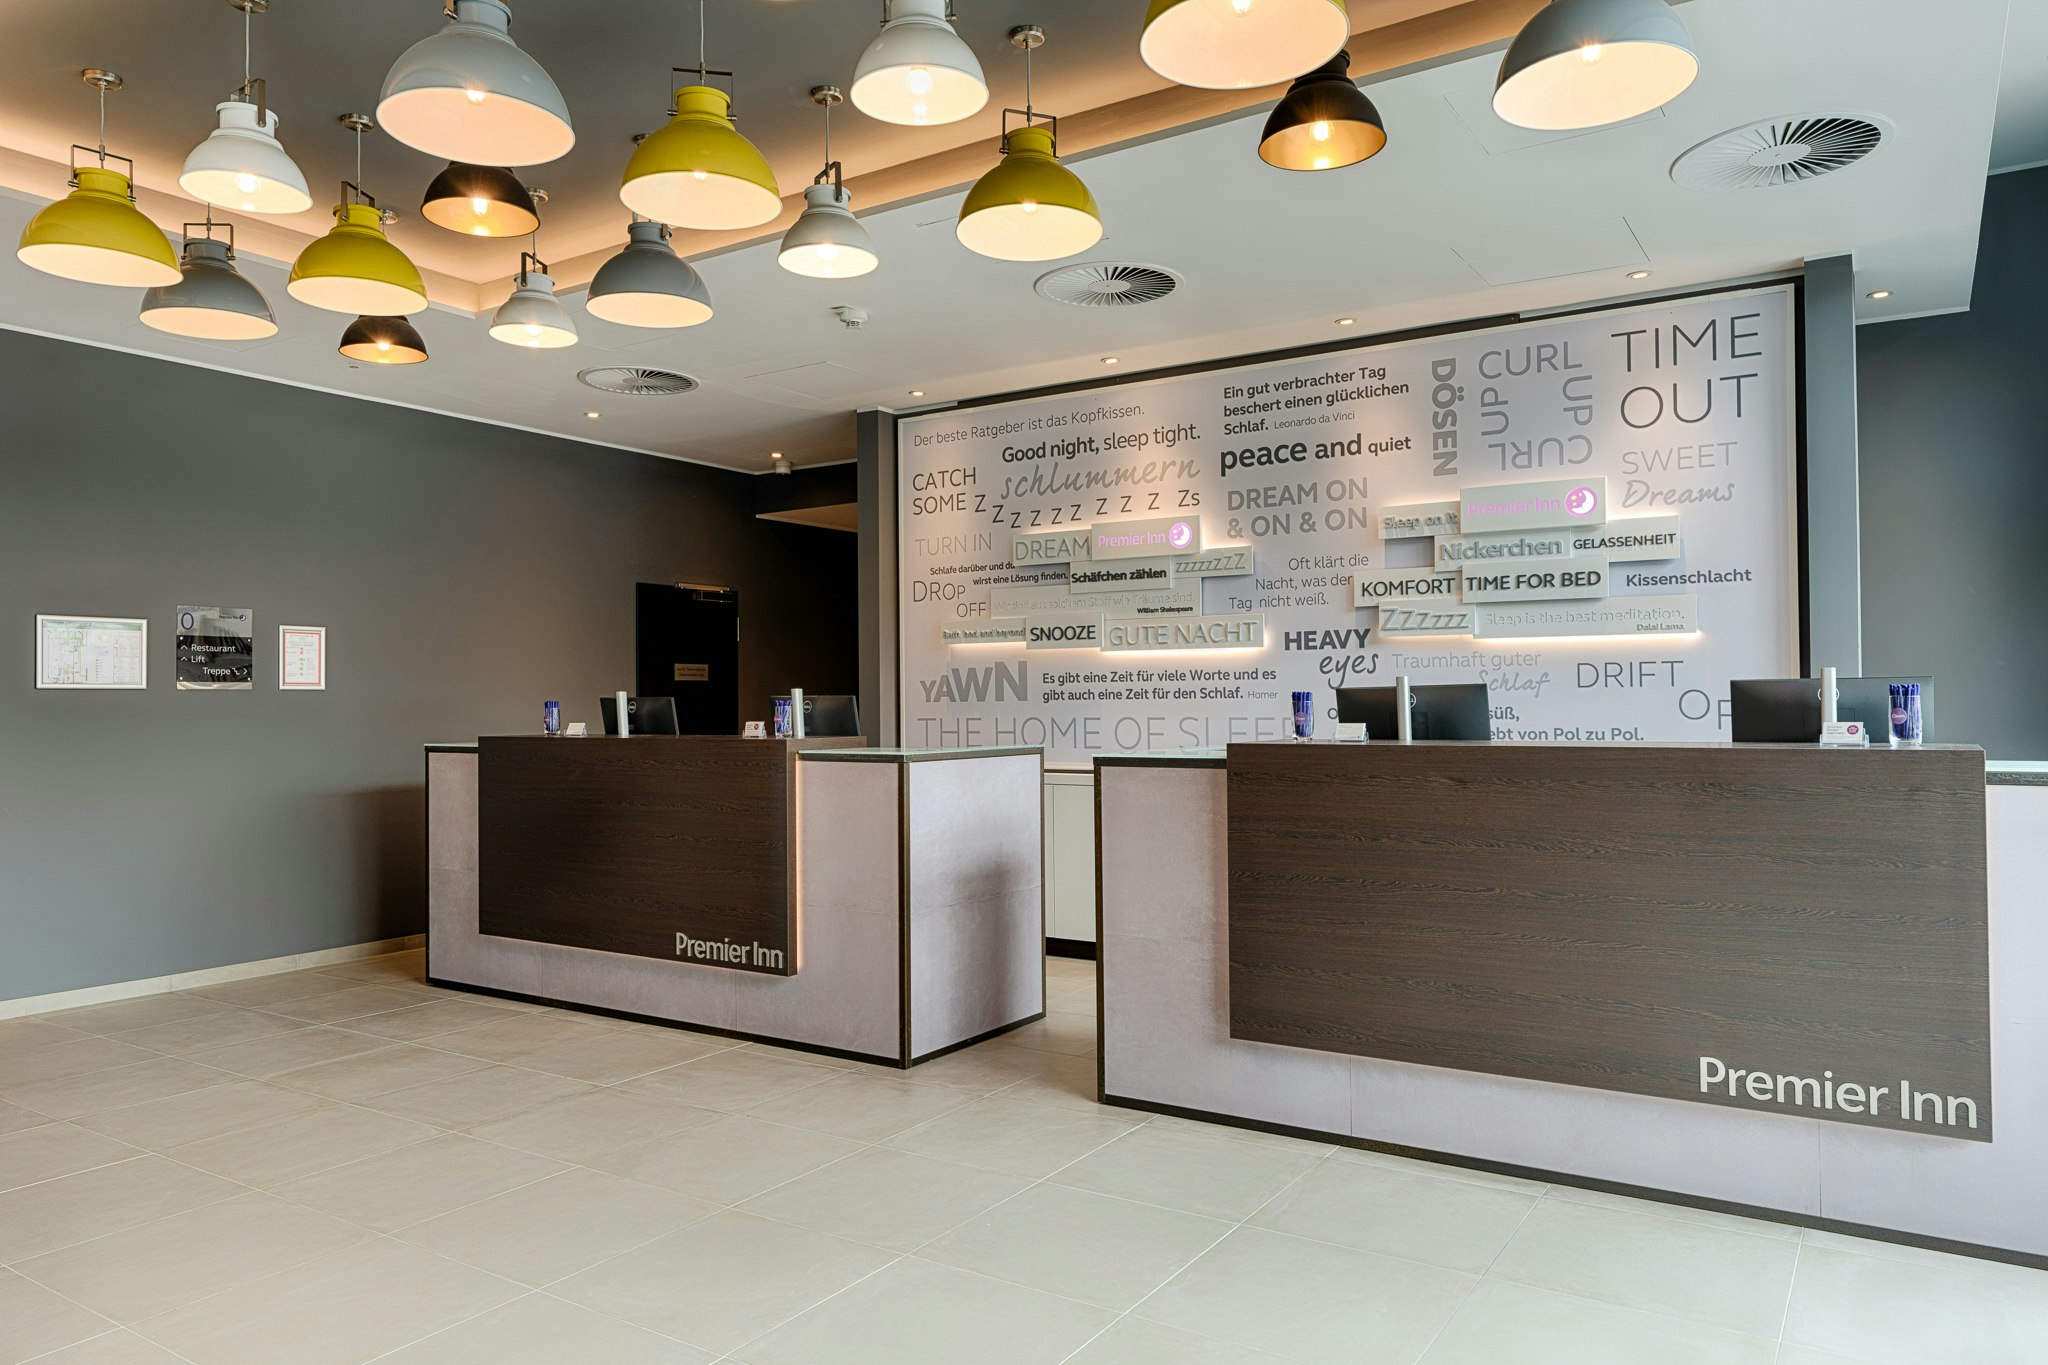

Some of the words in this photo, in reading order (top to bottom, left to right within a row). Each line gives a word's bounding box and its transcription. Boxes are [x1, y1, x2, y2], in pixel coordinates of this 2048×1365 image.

[1611, 313, 1762, 372] TIME
[1478, 341, 1583, 379] CURL
[1224, 386, 1244, 400] Ein
[1246, 382, 1270, 398] gut
[1273, 370, 1356, 394] verbrachter
[1358, 366, 1386, 380] Tag
[1224, 401, 1282, 417] beschert
[1284, 395, 1322, 408] einen
[1326, 382, 1409, 407] glücklichen
[1480, 387, 1509, 436] UP
[1562, 375, 1593, 426] UP
[1620, 373, 1758, 428] OUT
[914, 435, 934, 446] Der
[936, 430, 968, 444] beste
[971, 420, 1025, 439] Ratgeber
[1028, 417, 1042, 430] ist
[1046, 414, 1068, 428] das
[1071, 405, 1145, 425] Kopfkissen.
[1224, 419, 1269, 436] Schlaf.
[1274, 416, 1317, 429] Leonardo
[1318, 414, 1330, 424] da
[1332, 411, 1355, 422] Vinci
[1431, 357, 1465, 476] DÖSEN
[1002, 441, 1046, 463] Good
[1050, 436, 1100, 459] night,
[1104, 432, 1148, 451] sleep
[1153, 424, 1201, 448] tight.
[1220, 441, 1307, 477] peace
[1314, 433, 1362, 460] and
[1368, 436, 1412, 457] quiet
[1488, 434, 1593, 470] CURL
[1622, 442, 1738, 475] SWEET
[912, 466, 976, 492] CATCH
[1001, 459, 1200, 500] schlummern
[912, 492, 966, 516] SOME
[1228, 482, 1318, 511] DREAM
[1326, 477, 1368, 502] ON
[1622, 479, 1736, 508] Dreams
[1468, 499, 1530, 518] Premier
[1535, 497, 1560, 513] Inn
[1226, 518, 1244, 538] &
[1250, 513, 1290, 537] ON
[1300, 512, 1317, 533] &
[1324, 507, 1367, 530] ON
[1384, 516, 1420, 530] Sleep
[1426, 515, 1442, 526] on
[914, 535, 967, 557] TURN
[974, 532, 992, 552] IN
[1015, 536, 1090, 560] DREAM
[1098, 533, 1145, 548] Premier
[1148, 532, 1166, 544] Inn
[1440, 538, 1562, 560] Nickerchen
[1573, 533, 1676, 550] GELASSENHEIT
[930, 566, 957, 576] Schlafe
[958, 563, 987, 574] darüber
[988, 562, 1004, 570] und
[1288, 556, 1310, 570] Oft
[1314, 555, 1344, 568] klärt
[1348, 554, 1369, 566] die
[972, 576, 992, 586] wirst
[992, 576, 1010, 584] eine
[1010, 574, 1039, 585] Lösung
[1040, 572, 1069, 580] finden.
[1071, 570, 1128, 584] Schäfchen
[1129, 568, 1167, 580] zählen
[1255, 577, 1298, 590] Nacht,
[1301, 576, 1326, 588] was
[1330, 574, 1353, 586] der
[1362, 578, 1456, 598] KOMFORT
[1466, 575, 1511, 592] TIME
[1516, 573, 1555, 589] FOR
[1561, 570, 1602, 587] BED
[1626, 568, 1752, 588] Kissenschlacht
[913, 580, 966, 602] DROP
[1132, 593, 1171, 604] Träume
[1228, 598, 1252, 611] Tag
[1259, 595, 1291, 608] nicht
[1294, 592, 1329, 606] weiß.
[956, 602, 987, 618] OFF
[1486, 613, 1522, 626] Sleep
[1526, 612, 1536, 624] is
[1540, 611, 1562, 624] the
[1566, 610, 1597, 622] best
[1600, 608, 1685, 622] meditation.
[1030, 625, 1096, 642] SNOOZE
[1110, 625, 1169, 646] GUTE
[1176, 622, 1258, 645] NACHT
[1284, 628, 1371, 650] HEAVY
[191, 644, 236, 652] Restaurant
[202, 667, 230, 676] Treppe
[1319, 654, 1378, 690] eyes
[1392, 652, 1486, 668] Traumhaft
[1491, 652, 1542, 671] guter
[920, 660, 1028, 702] YAWN
[1042, 673, 1055, 684] Es
[1058, 672, 1080, 686] gibt
[1083, 672, 1108, 683] eine
[1110, 670, 1134, 682] Zeit
[1136, 670, 1154, 682] für
[1158, 670, 1186, 681] viele
[1190, 670, 1230, 681] Worte
[1234, 668, 1258, 680] und
[1262, 670, 1276, 680] es
[1479, 670, 1551, 698] Schlaf
[1577, 660, 1684, 688] DRIFT
[1042, 690, 1066, 704] gibt
[1068, 689, 1096, 700] auch
[1098, 690, 1122, 700] eine
[1126, 688, 1150, 700] Zeit
[1152, 688, 1170, 699] für
[1174, 688, 1197, 699] den
[1200, 686, 1244, 699] Schlaf.
[1248, 690, 1278, 699] Homer
[917, 717, 982, 747] THE
[995, 716, 1102, 749] HOME
[1114, 716, 1166, 751] OF
[1518, 730, 1548, 740] von
[1554, 726, 1580, 741] Pol
[1585, 730, 1606, 741] zu
[1610, 726, 1644, 741] Pol.
[676, 932, 750, 964] Premier
[753, 942, 783, 968] Inn
[1700, 1056, 1889, 1116] Premier
[1900, 1080, 1978, 1128] Inn
